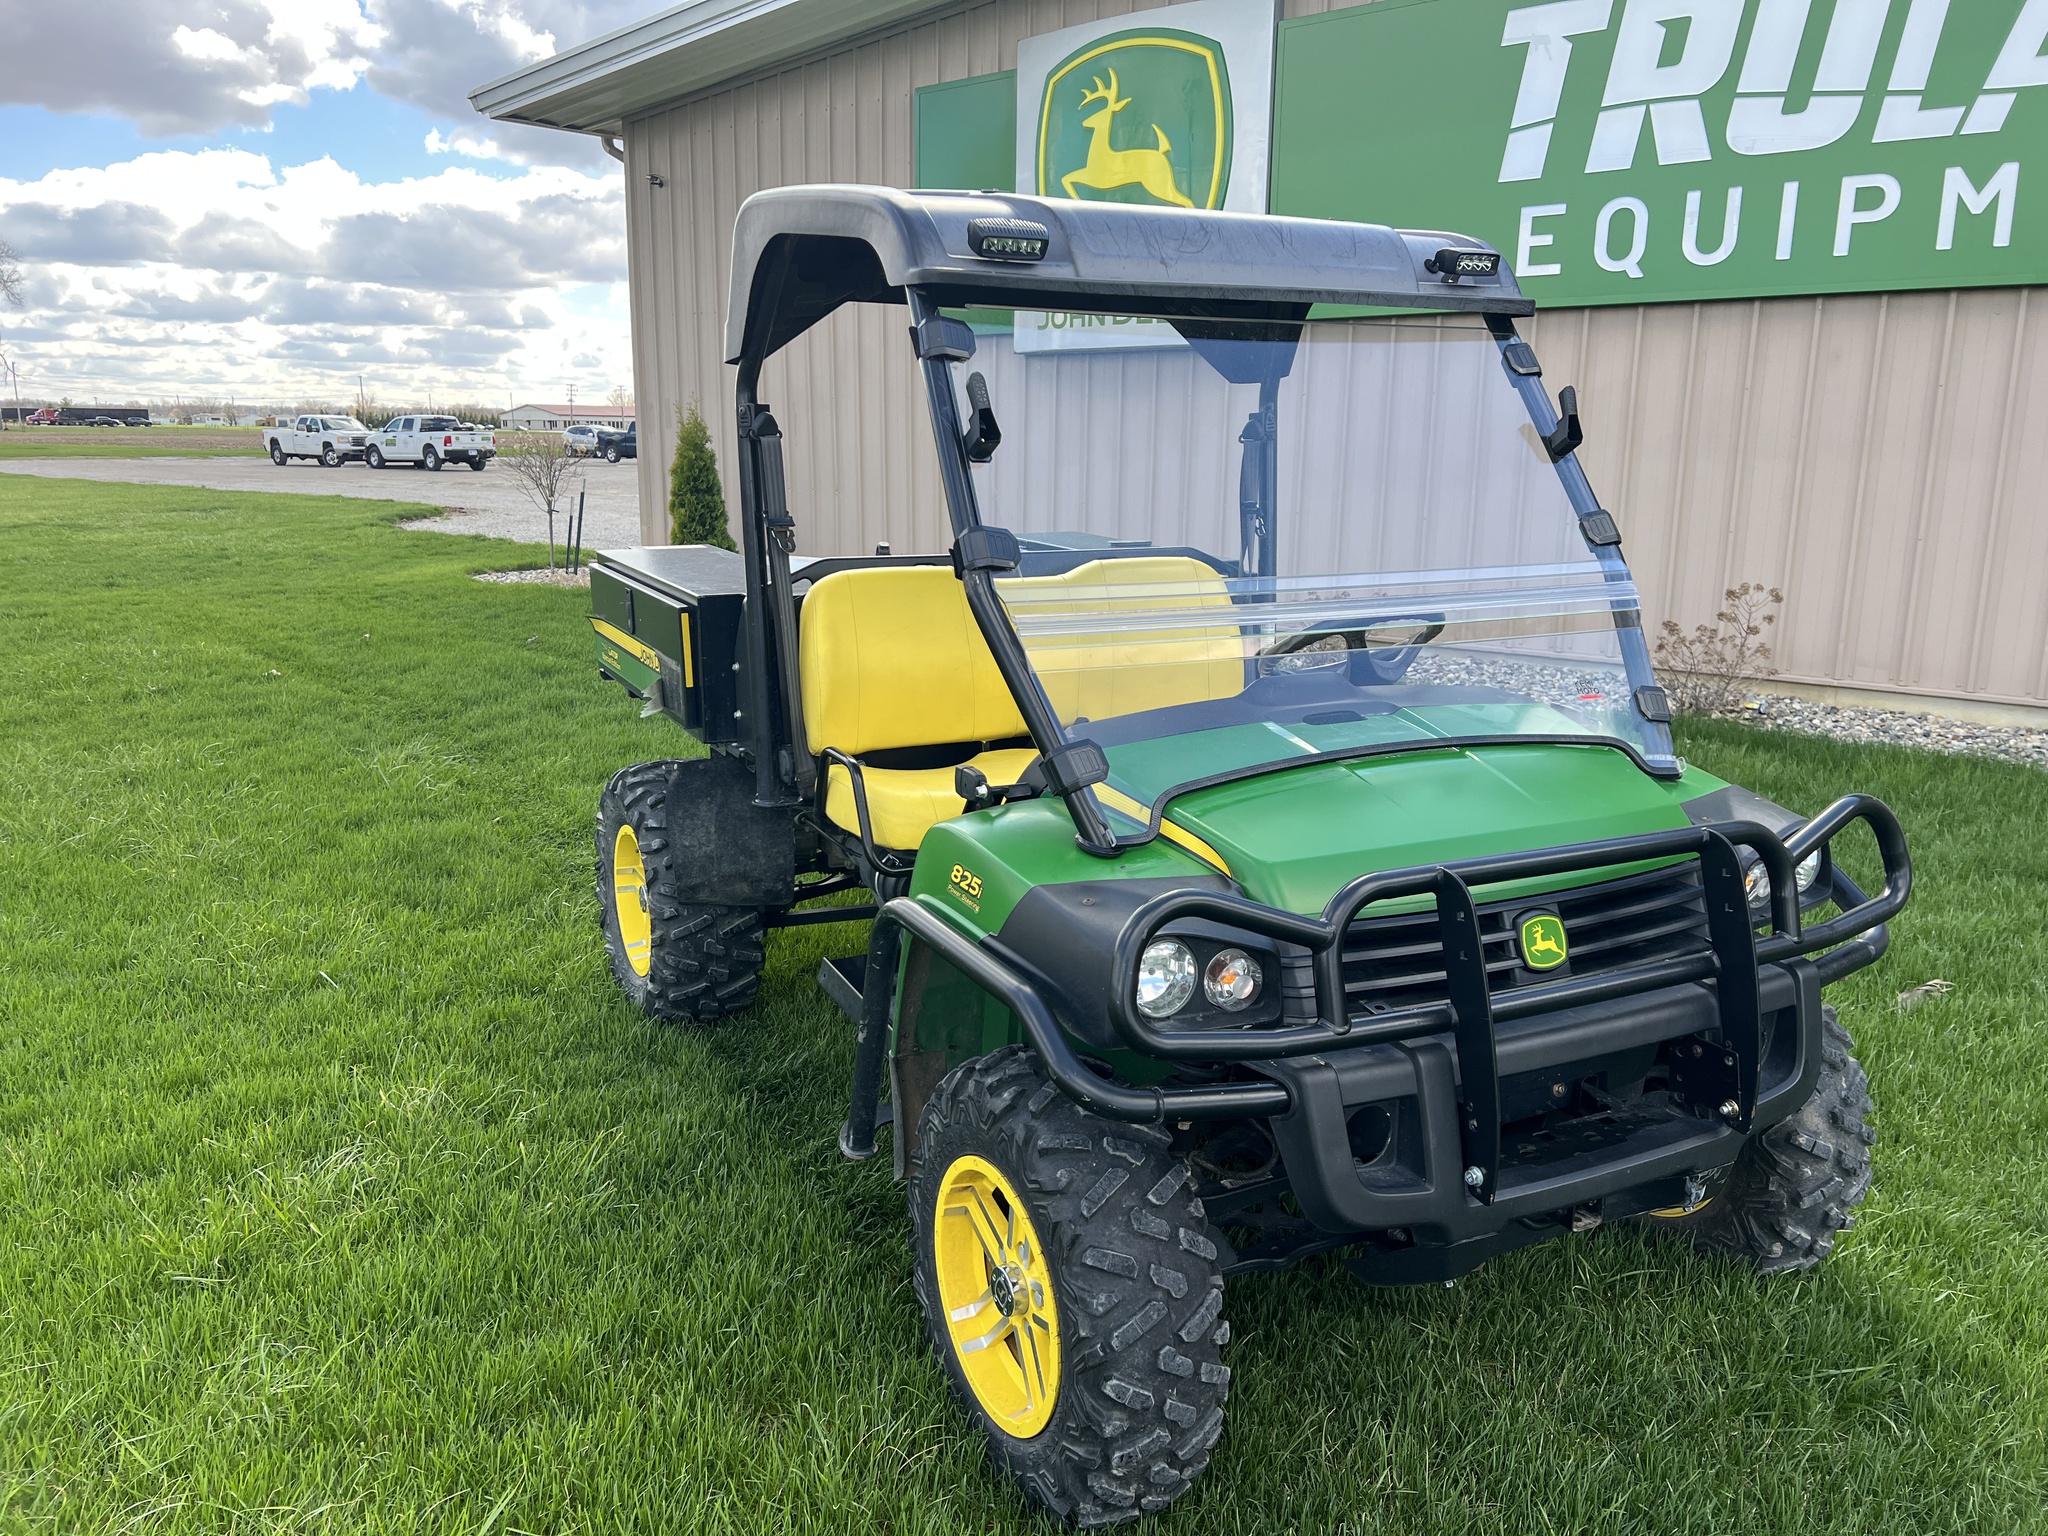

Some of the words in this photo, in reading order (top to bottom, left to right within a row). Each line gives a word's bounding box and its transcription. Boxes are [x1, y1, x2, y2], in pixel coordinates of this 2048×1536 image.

[1516, 162, 2020, 279] EQUIPM
[947, 884, 963, 898] Power
[950, 864, 983, 899] 825i
